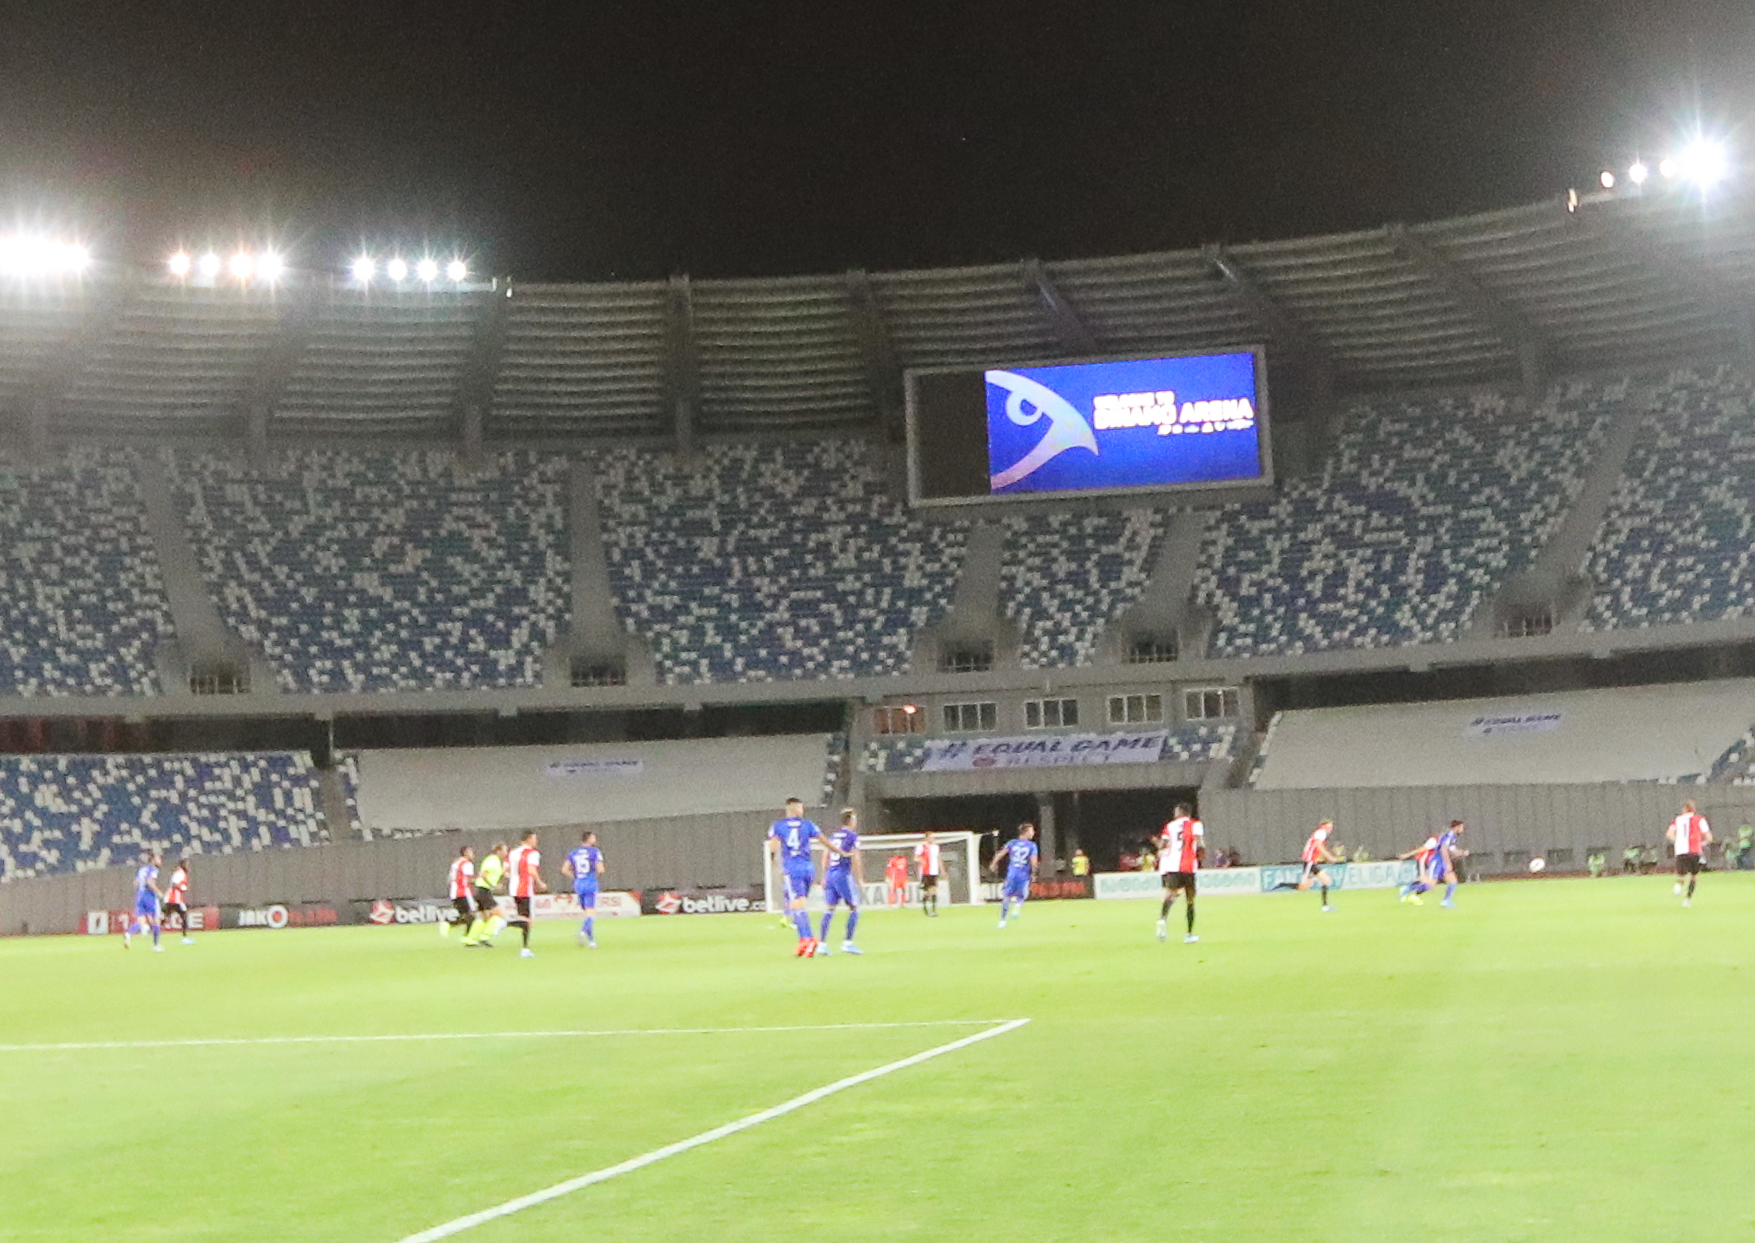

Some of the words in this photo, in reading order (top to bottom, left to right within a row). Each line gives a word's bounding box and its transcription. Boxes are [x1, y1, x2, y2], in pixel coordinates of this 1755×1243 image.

[1094, 405, 1177, 430] DINAMO
[1179, 397, 1254, 423] ARENA
[1070, 736, 1163, 753] GAME
[788, 829, 801, 850] 4
